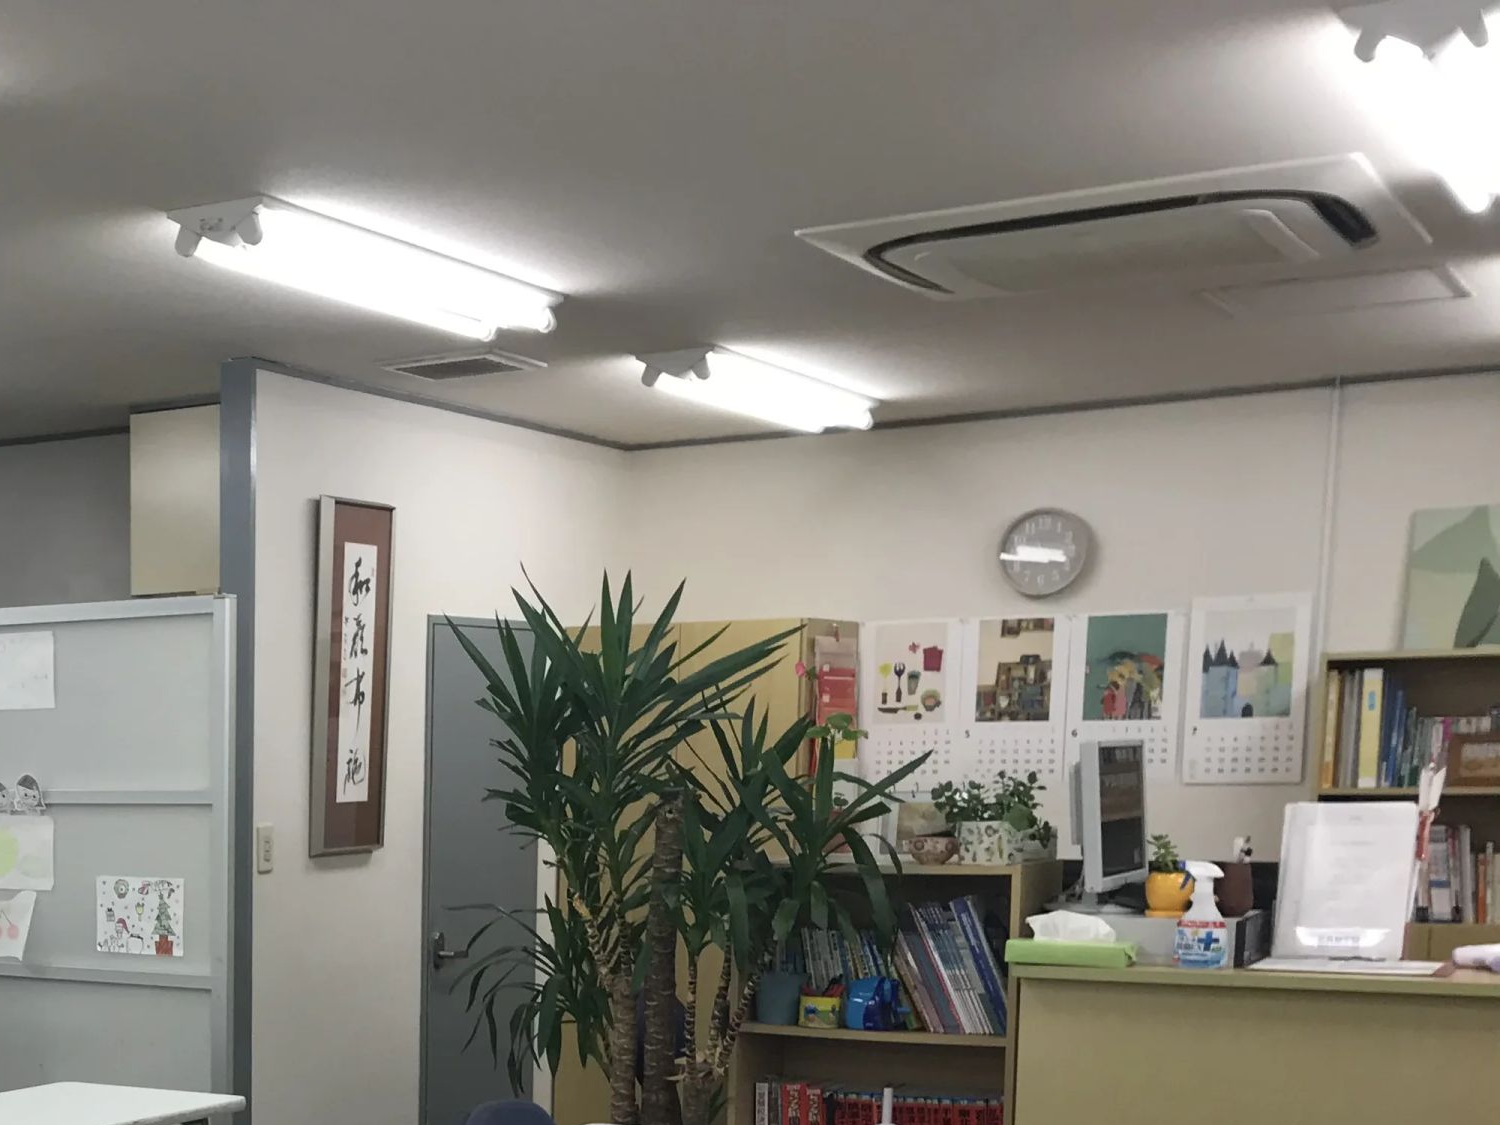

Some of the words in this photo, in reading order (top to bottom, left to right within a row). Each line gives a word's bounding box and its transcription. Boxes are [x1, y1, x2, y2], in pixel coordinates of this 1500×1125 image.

[1025, 521, 1036, 535] 11
[965, 730, 970, 739] 5
[1071, 728, 1078, 738] 6
